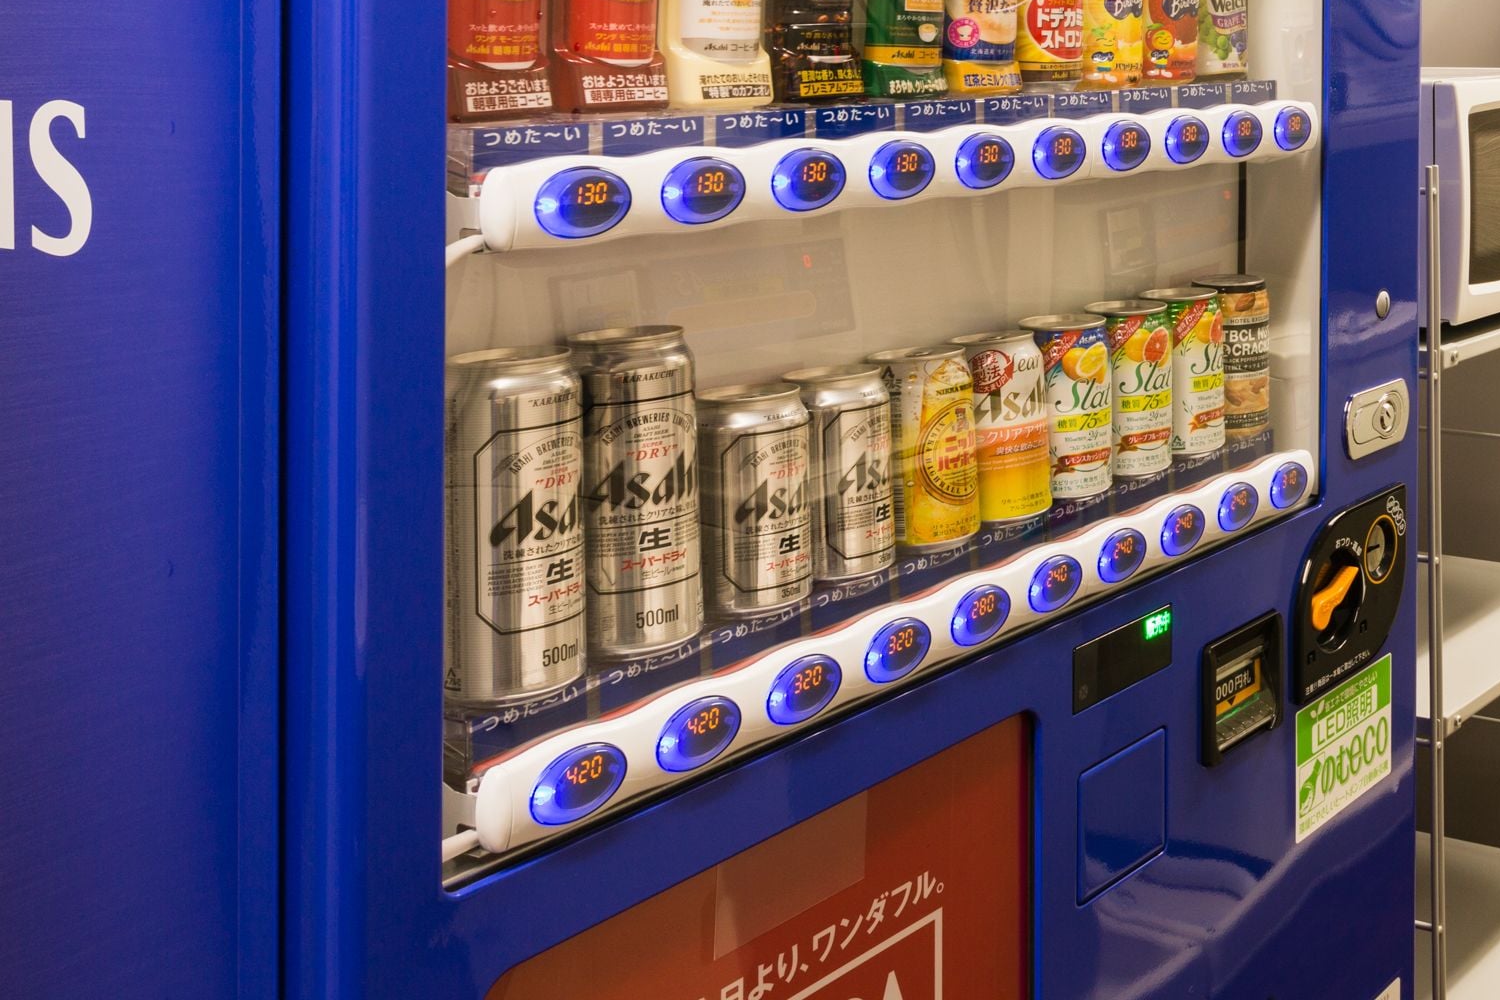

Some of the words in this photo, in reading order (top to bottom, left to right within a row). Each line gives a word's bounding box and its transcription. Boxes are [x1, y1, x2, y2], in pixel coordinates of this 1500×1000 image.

[1217, 16, 1240, 28] GRAPE
[583, 74, 667, 89] おはようございます
[471, 95, 550, 111] 朝専用缶コーヒー
[591, 89, 667, 103] 朝専用缶コーヒー
[1182, 124, 1197, 142] 130
[1237, 120, 1251, 136] 130
[1288, 115, 1302, 131] 130
[1054, 137, 1072, 156] 130
[1121, 130, 1137, 148] 130
[896, 152, 918, 173] 130
[979, 144, 999, 164] 130
[697, 171, 725, 193] 130
[802, 162, 827, 182] 130
[578, 182, 608, 206] 130
[1192, 379, 1209, 390] 糖質
[1121, 398, 1141, 409] 糖質
[602, 426, 623, 446] ASAHI
[626, 412, 671, 430] BREWERIES
[1057, 417, 1077, 429] 糖質
[509, 454, 534, 475] ASAHI
[536, 436, 574, 455] BREWERIES
[1282, 468, 1297, 489] 310
[1231, 489, 1248, 510] 240
[875, 503, 891, 523] 生
[1174, 513, 1194, 534] 240
[638, 528, 672, 552] 生
[779, 534, 801, 555] 生
[1113, 537, 1134, 560] 240
[621, 549, 688, 572] スーパードライ
[546, 559, 574, 585] 生
[1046, 564, 1068, 588] 240
[636, 604, 679, 629] 500ml
[971, 594, 995, 619] 280
[888, 628, 914, 655] 320
[543, 639, 579, 667] 500ml
[794, 665, 823, 694] 320
[687, 707, 720, 735] 420
[1316, 688, 1374, 747] LED照明
[566, 755, 603, 785] 420
[700, 870, 944, 1000] 日より、ワンダフル。
